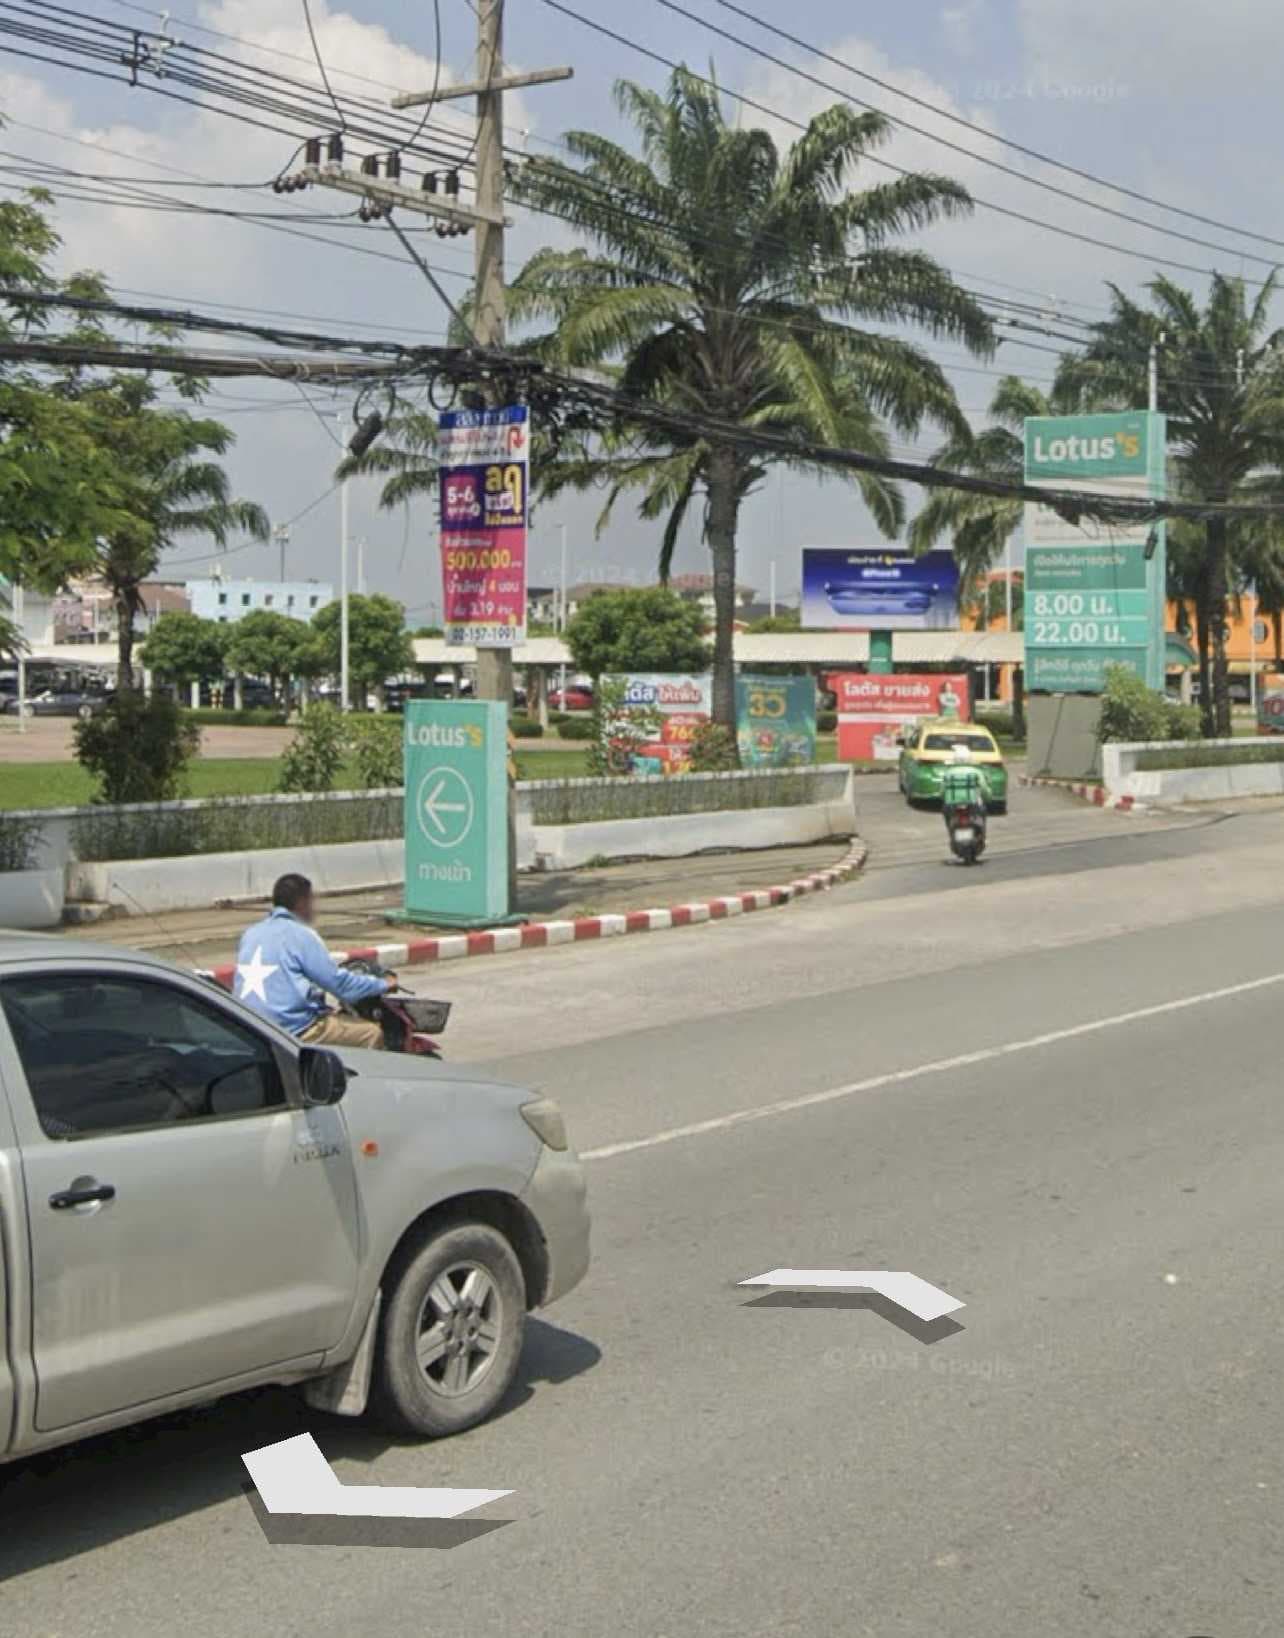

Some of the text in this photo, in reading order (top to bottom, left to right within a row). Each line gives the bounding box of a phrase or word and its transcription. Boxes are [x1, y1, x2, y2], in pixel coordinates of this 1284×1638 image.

[1034, 432, 1139, 462] Lotus's
[1034, 594, 1083, 616] 8.00
[1034, 622, 1099, 643] 22.00
[407, 721, 484, 748] Lotus's
